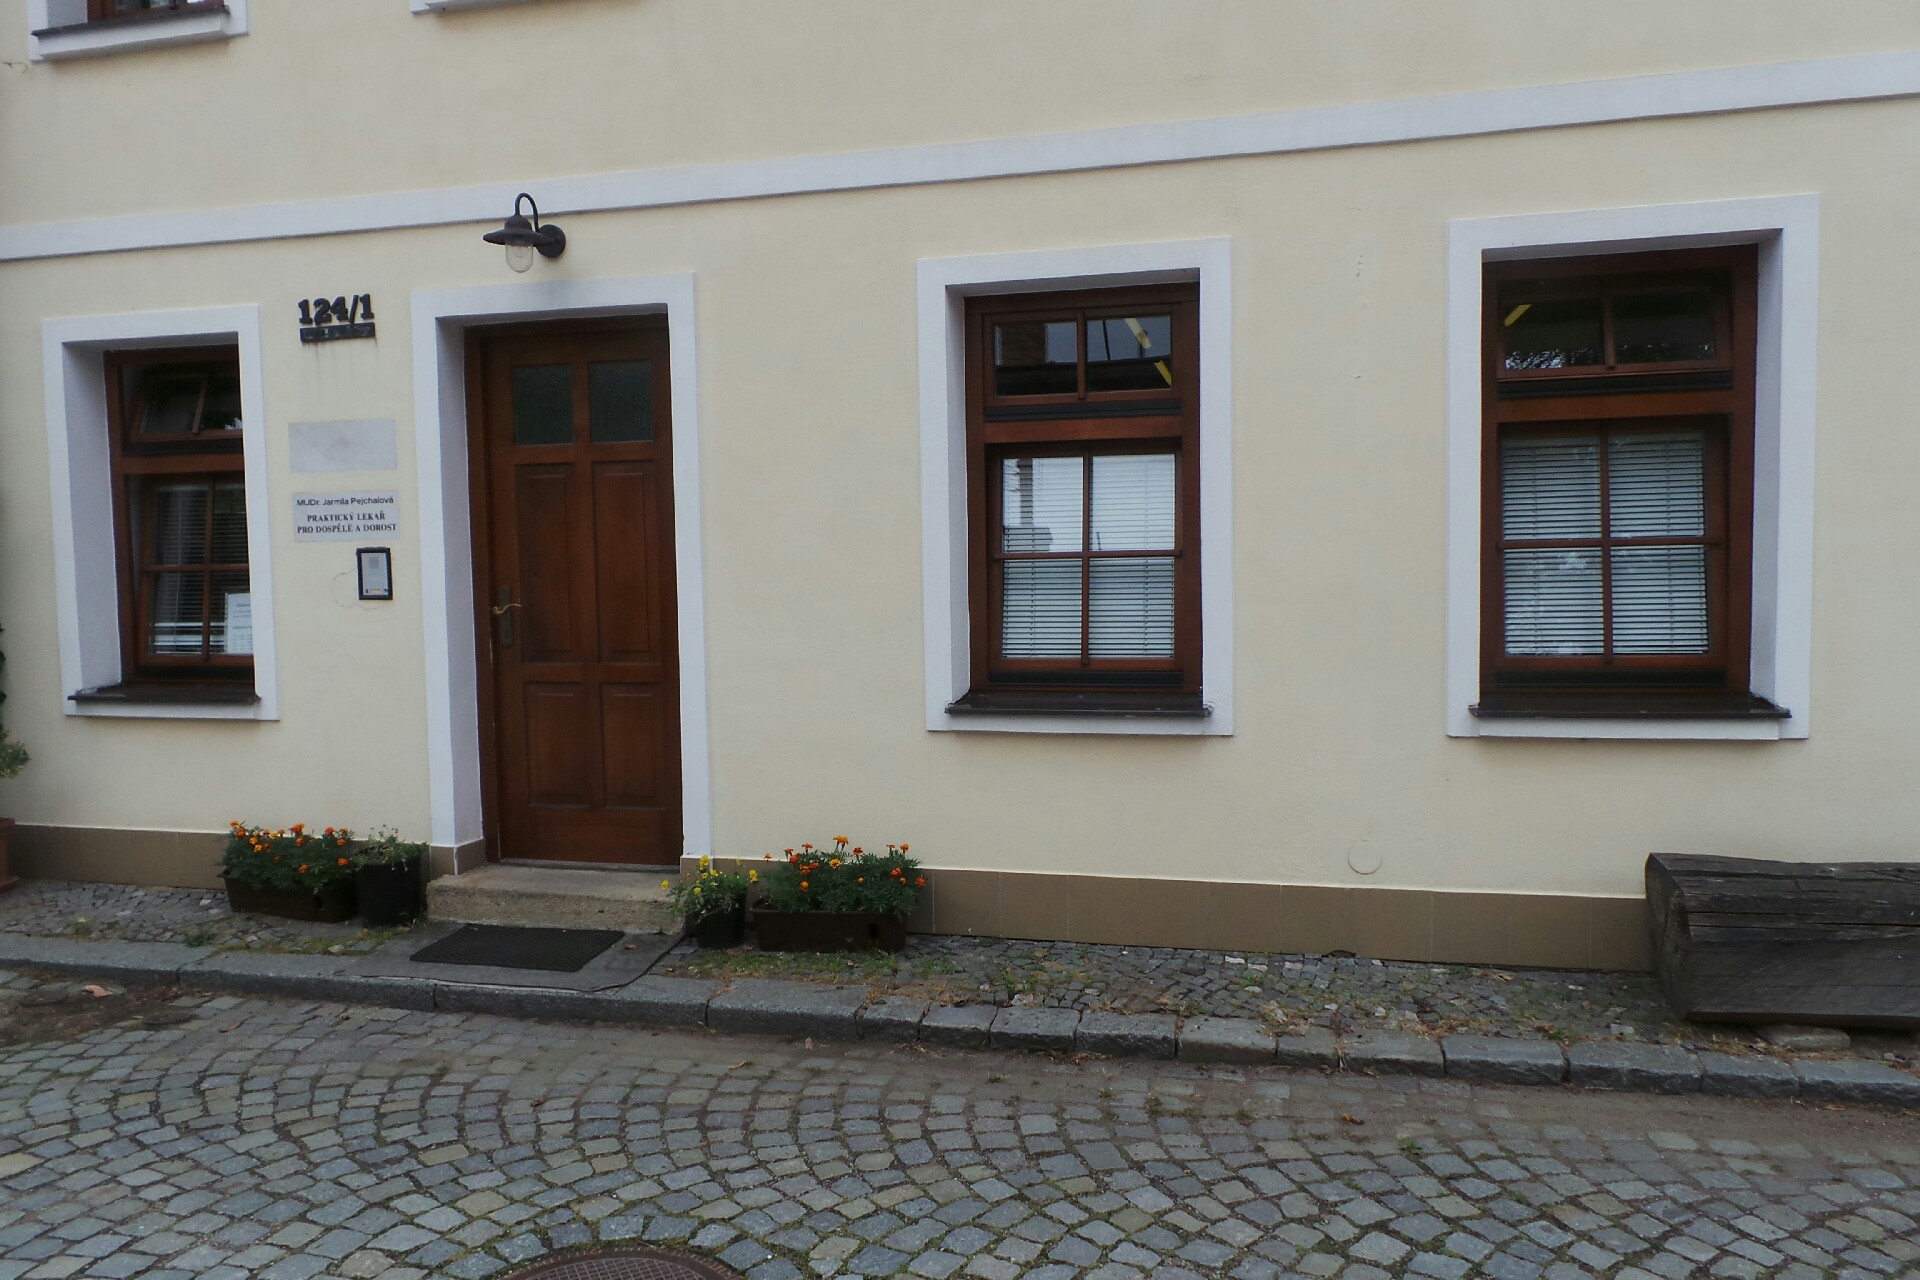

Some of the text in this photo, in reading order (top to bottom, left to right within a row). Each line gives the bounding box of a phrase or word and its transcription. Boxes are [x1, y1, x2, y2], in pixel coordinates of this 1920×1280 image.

[298, 293, 375, 325] 124/1
[323, 497, 350, 506] Jarmila
[351, 496, 394, 506] Pejchalová
[307, 512, 354, 523] PRAKTICKÝ
[297, 526, 314, 534] PRO
[316, 523, 354, 534] DOSPĚLÉ
[363, 524, 398, 532] DOROST
